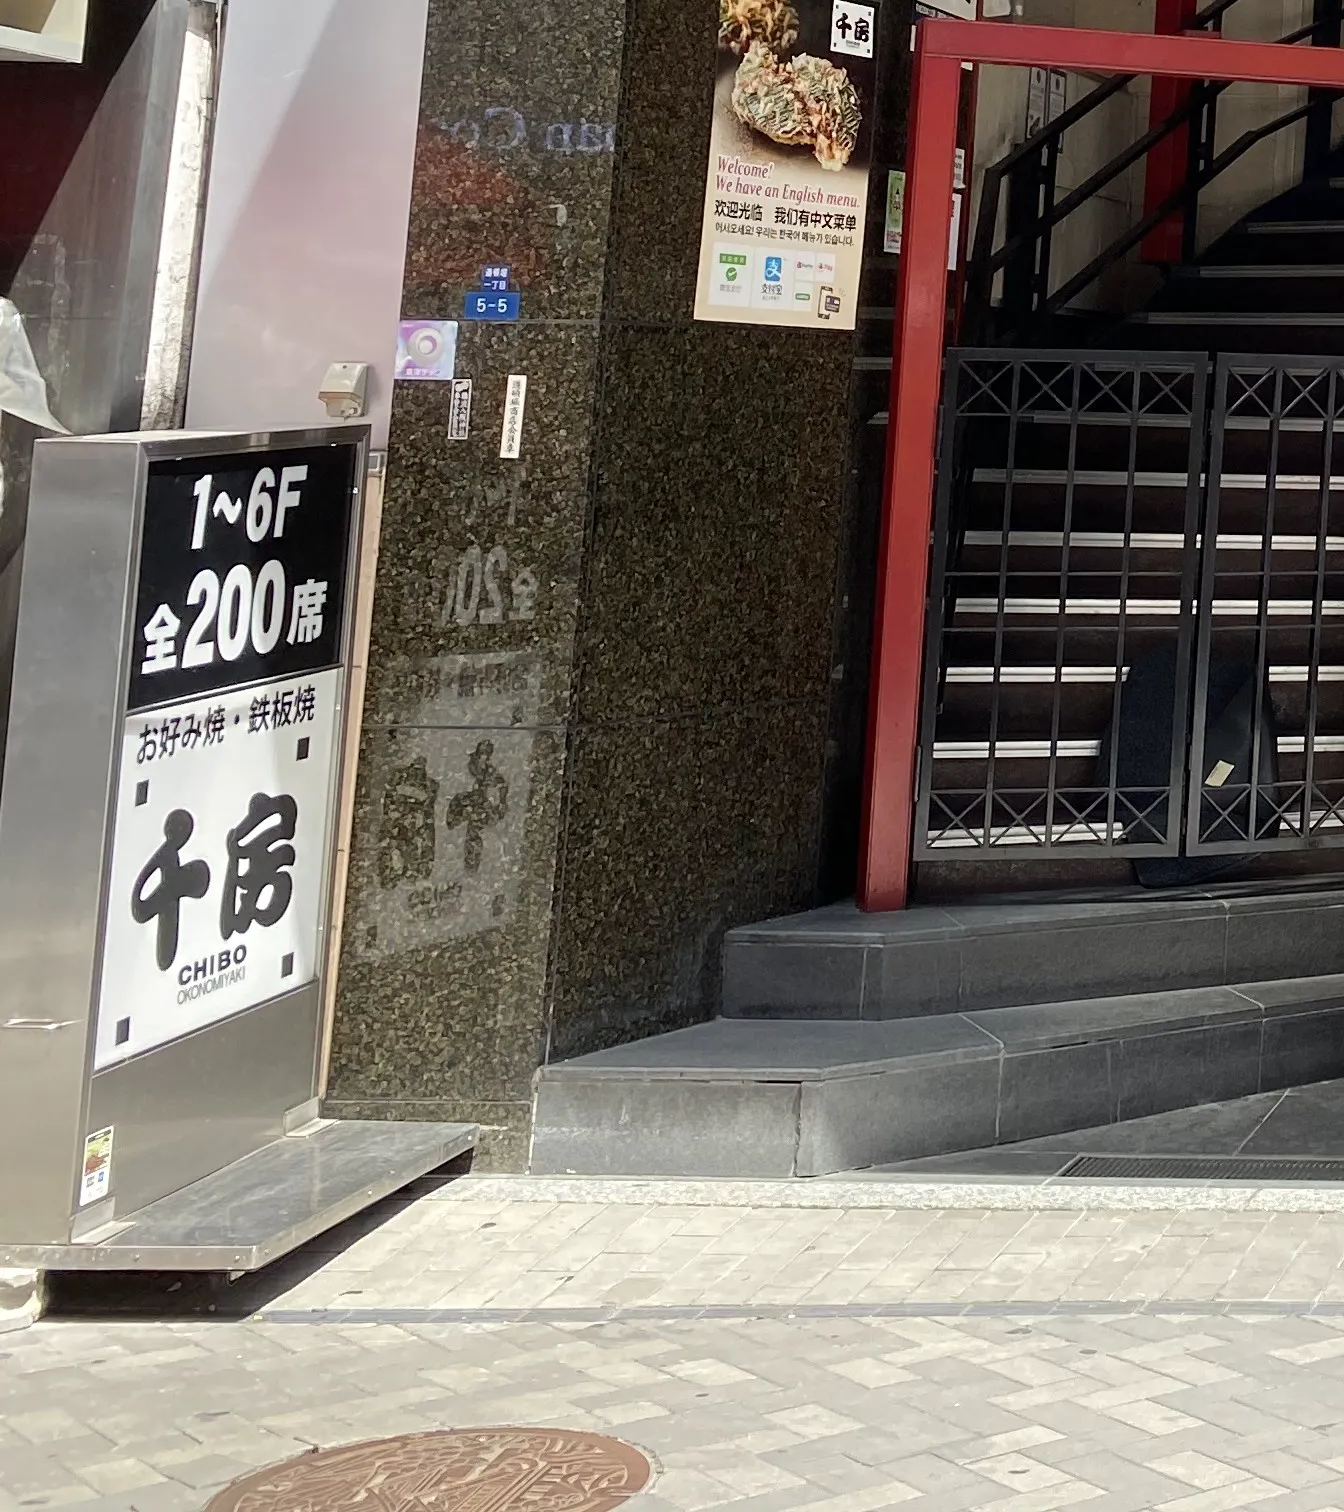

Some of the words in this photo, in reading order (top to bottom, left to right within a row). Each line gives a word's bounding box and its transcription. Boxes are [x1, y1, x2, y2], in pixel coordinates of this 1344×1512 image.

[835, 13, 870, 43] 千房
[717, 156, 773, 179] Welcome!
[716, 175, 733, 193] We
[735, 178, 762, 196] have
[764, 185, 779, 198] an
[783, 184, 824, 205] English
[826, 193, 861, 208] menu.
[715, 200, 763, 222] 欢迎光临
[774, 207, 857, 231] 我们有中文菜单
[476, 298, 508, 313] 5-5
[141, 560, 328, 675] 全200席
[136, 686, 316, 767] お好み焼・鉄板焼
[131, 792, 299, 972] 千房
[177, 944, 248, 986] CHIBO
[176, 966, 247, 1006] OKONOMIYAKI
